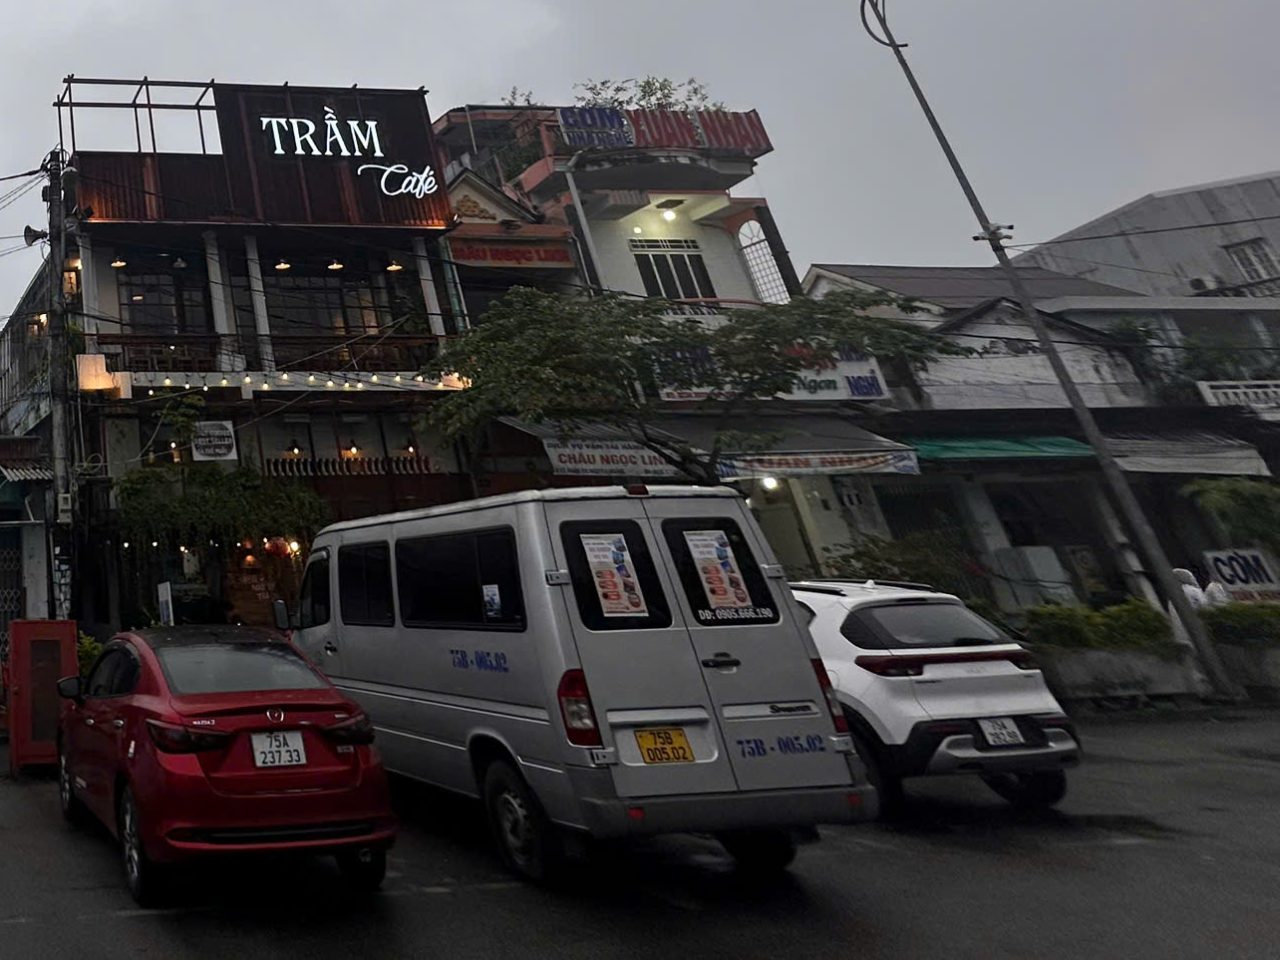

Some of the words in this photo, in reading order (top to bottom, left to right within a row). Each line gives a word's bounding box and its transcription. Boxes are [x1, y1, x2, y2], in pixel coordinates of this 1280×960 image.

[260, 106, 384, 157] TRẦM
[358, 165, 438, 198] Café
[267, 734, 289, 748] 75A
[649, 732, 673, 745] 75B
[646, 746, 688, 762] 005.02
[736, 739, 767, 758] 75B
[778, 736, 827, 754] 005.02
[260, 749, 301, 764] 237.33
